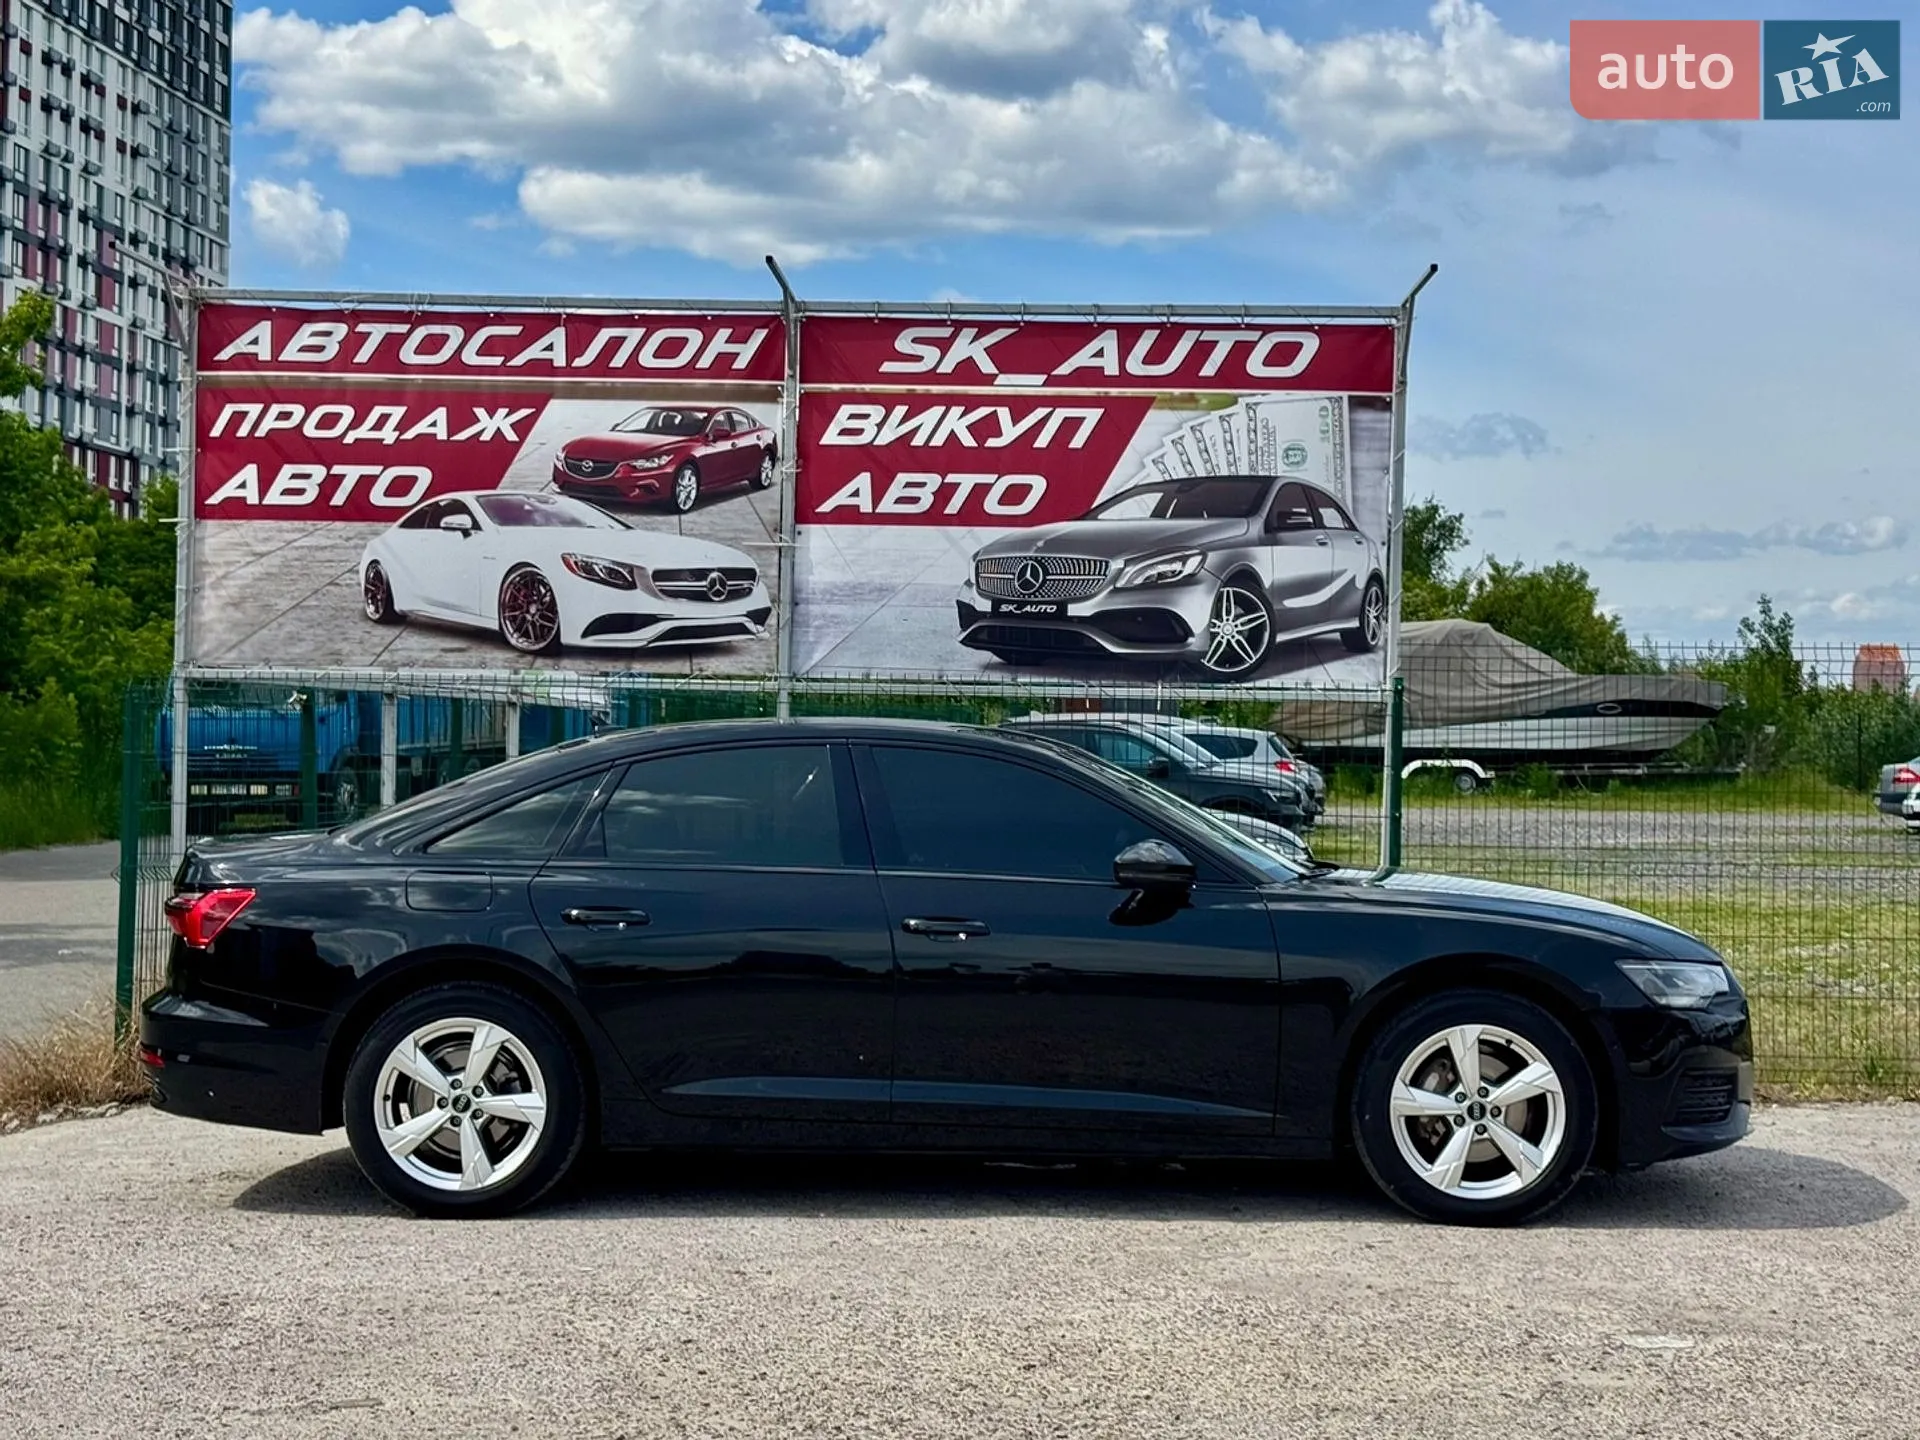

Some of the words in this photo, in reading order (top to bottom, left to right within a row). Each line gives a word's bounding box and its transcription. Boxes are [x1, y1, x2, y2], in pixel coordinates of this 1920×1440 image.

[213, 320, 770, 371] АВТОСАЛОН
[879, 326, 1321, 386] SK_AUTO
[209, 402, 536, 444] ПРОДАЖ
[819, 404, 1105, 448] ВИКУП
[204, 462, 433, 508] АВТО
[814, 471, 1048, 516] АВТО
[998, 603, 1058, 614] SK_AUTO
